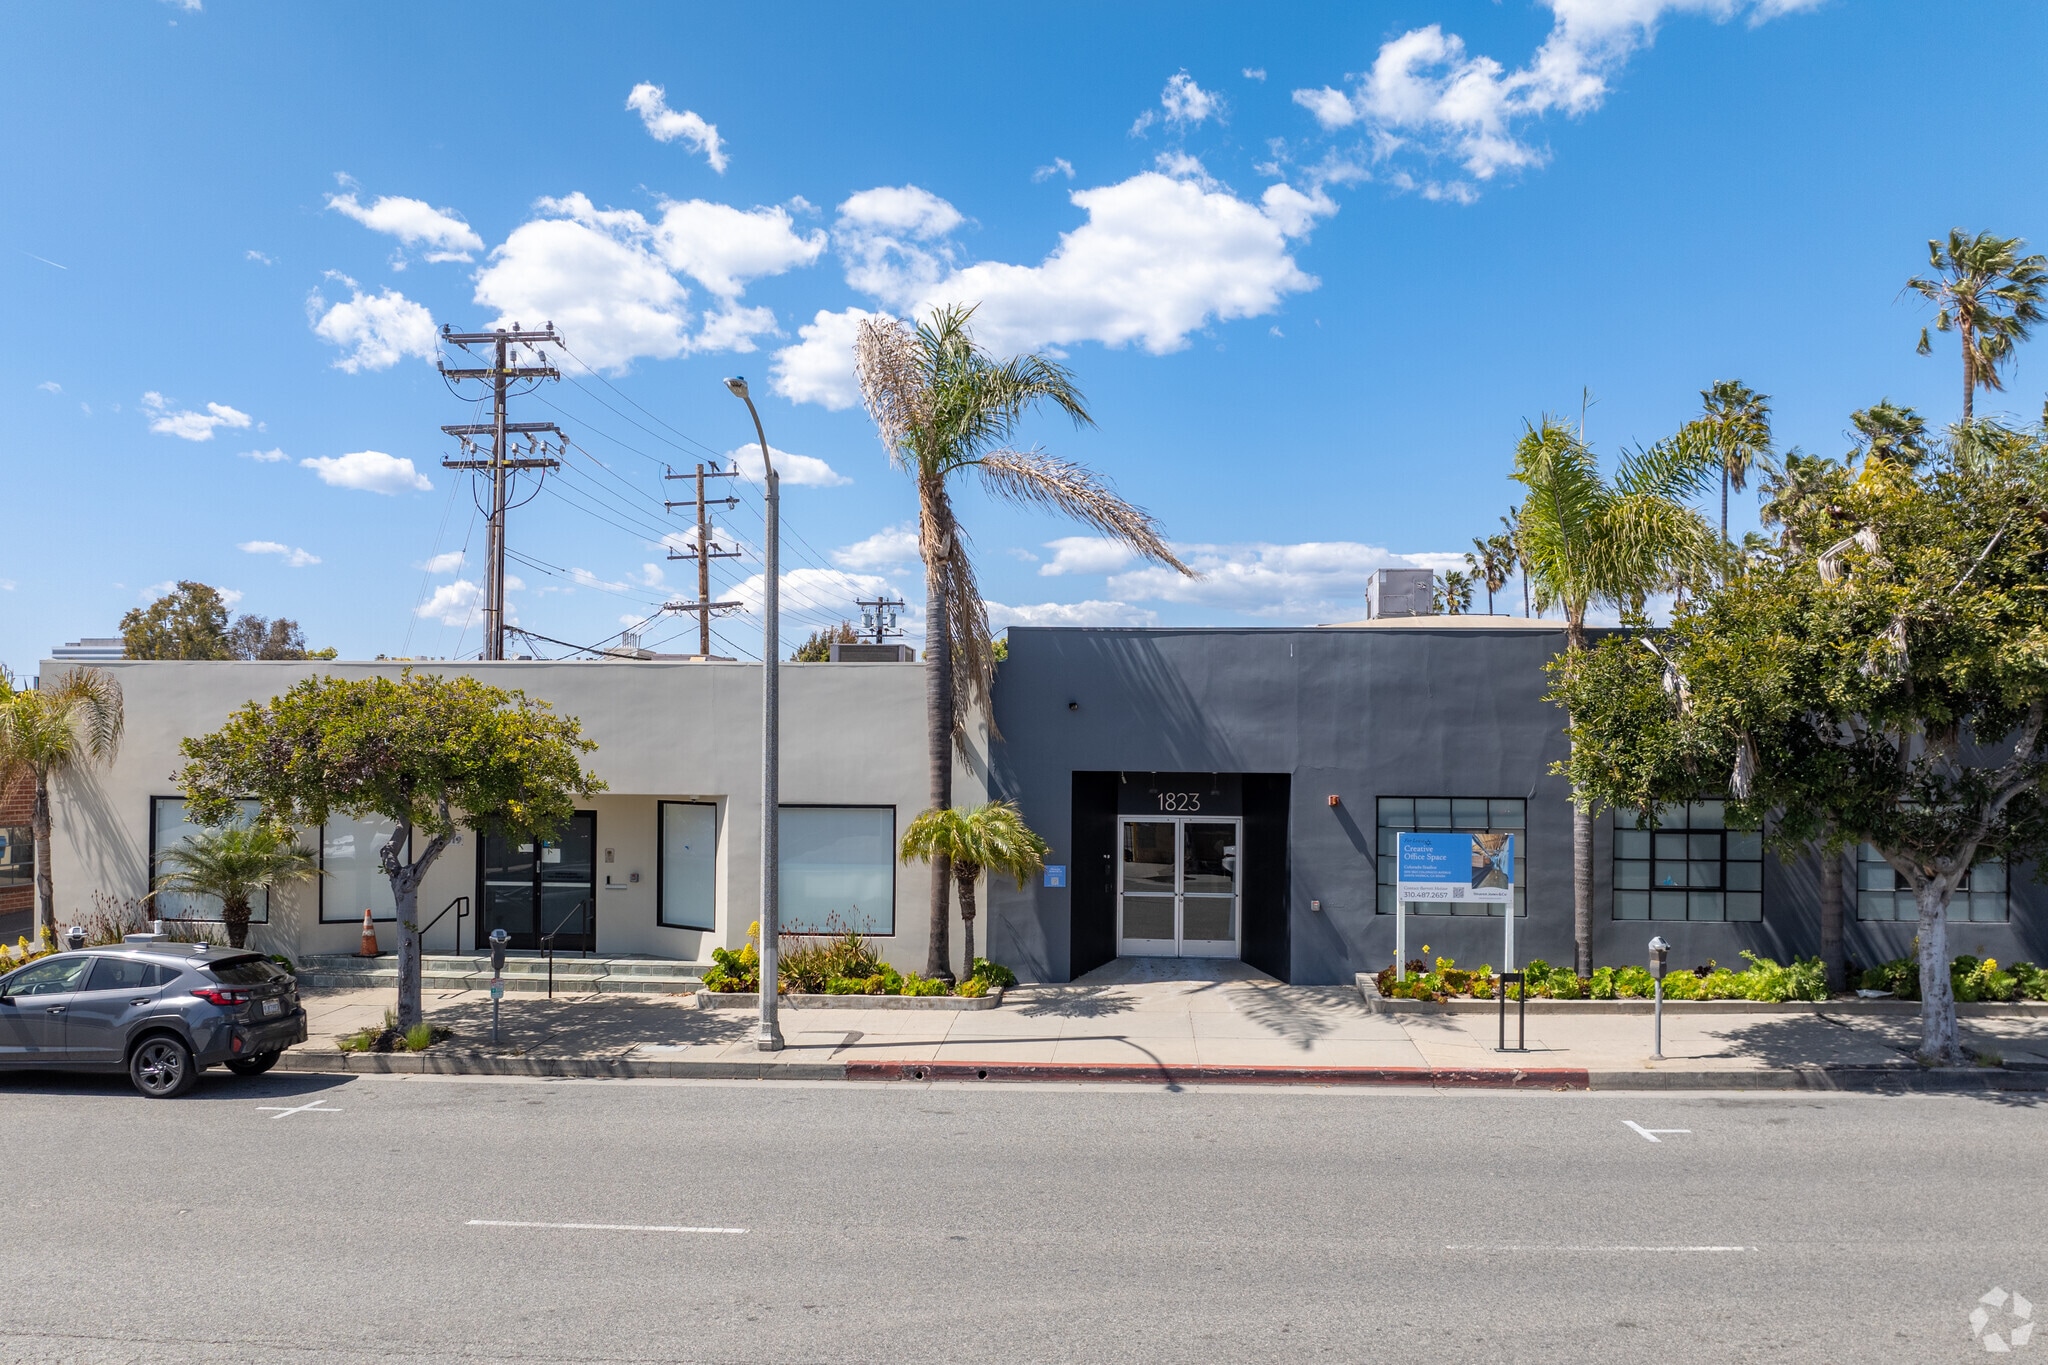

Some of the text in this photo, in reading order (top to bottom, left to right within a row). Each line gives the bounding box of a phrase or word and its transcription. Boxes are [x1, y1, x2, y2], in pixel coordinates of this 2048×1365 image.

[1157, 792, 1201, 812] 1823
[1404, 844, 1433, 852] Creative
[1426, 853, 1447, 862] Space
